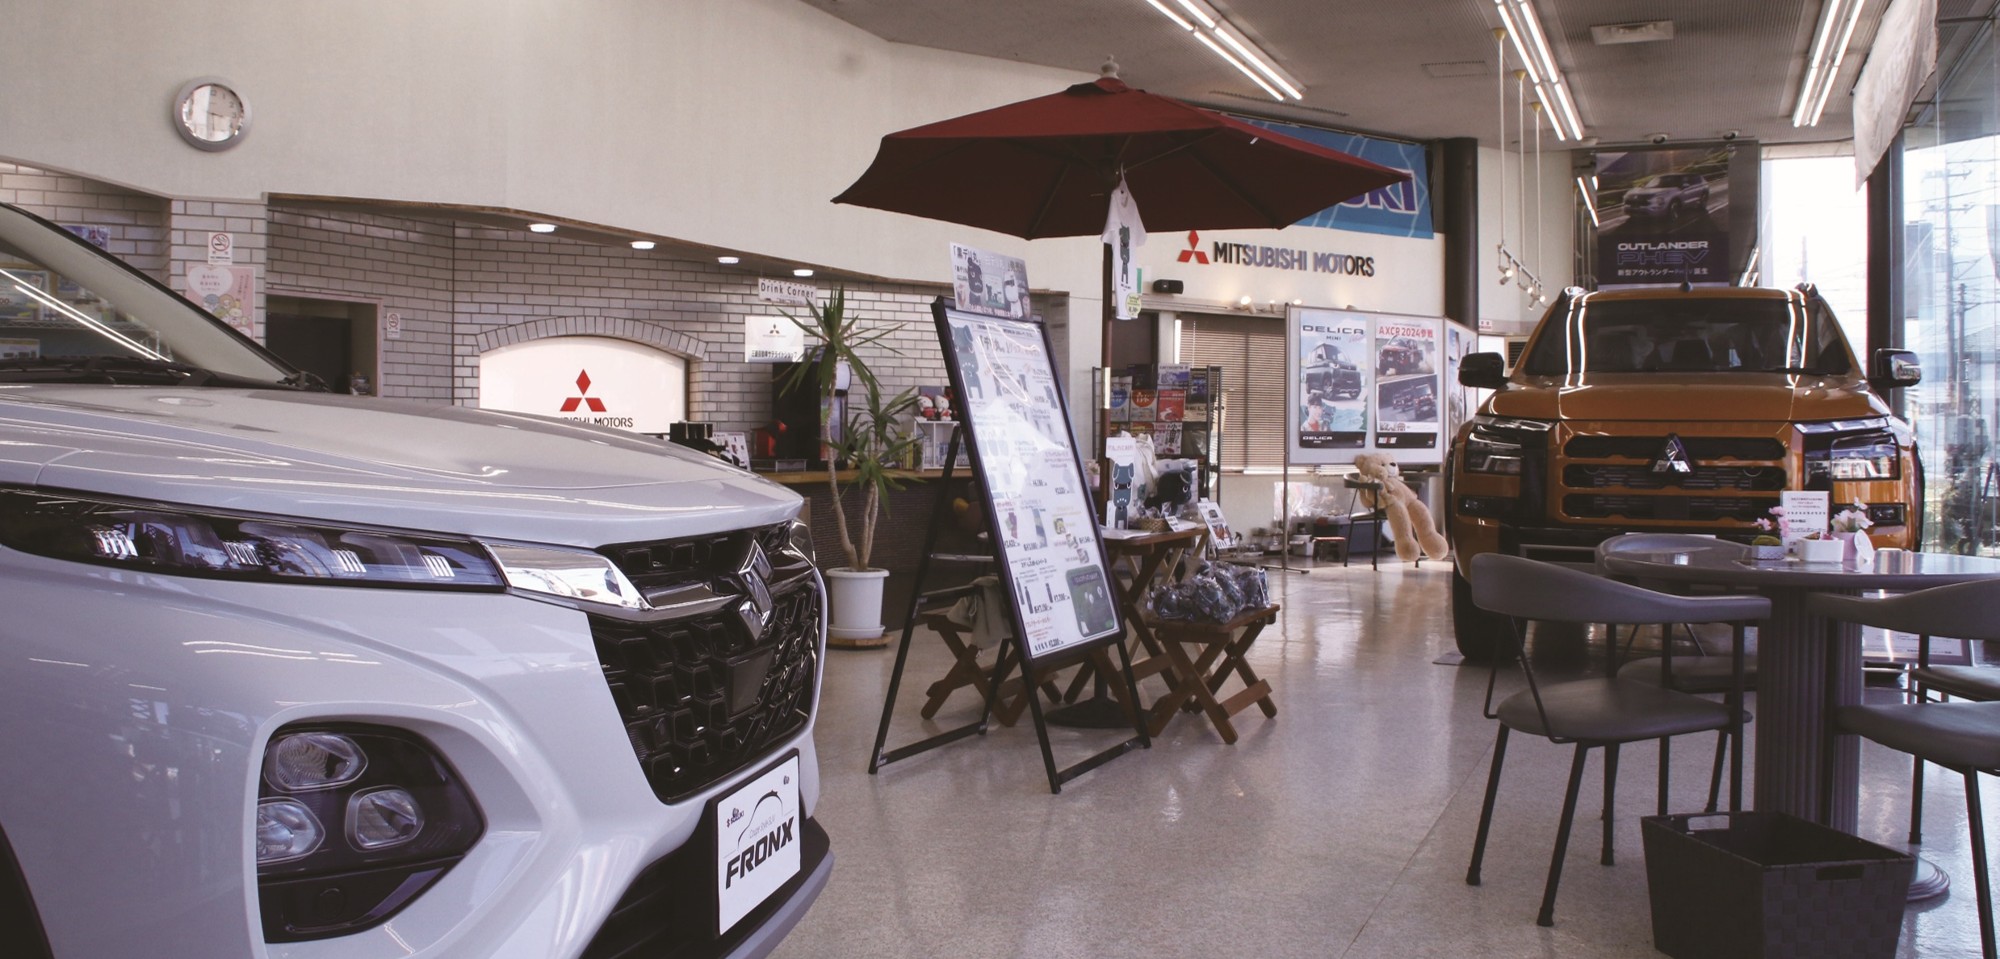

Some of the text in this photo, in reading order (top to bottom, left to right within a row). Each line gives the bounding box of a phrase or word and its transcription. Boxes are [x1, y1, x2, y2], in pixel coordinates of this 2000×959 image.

[1617, 241, 1708, 250] OUTLANDER
[1213, 241, 1375, 277] MITSUBISHI MOTORS
[1617, 250, 1709, 265] PHEV
[760, 282, 814, 298] Drink Corner
[1302, 324, 1365, 335] DELICA
[1379, 326, 1401, 336] AXCR
[594, 416, 634, 428] MOTORS
[726, 817, 794, 890] FRONX
